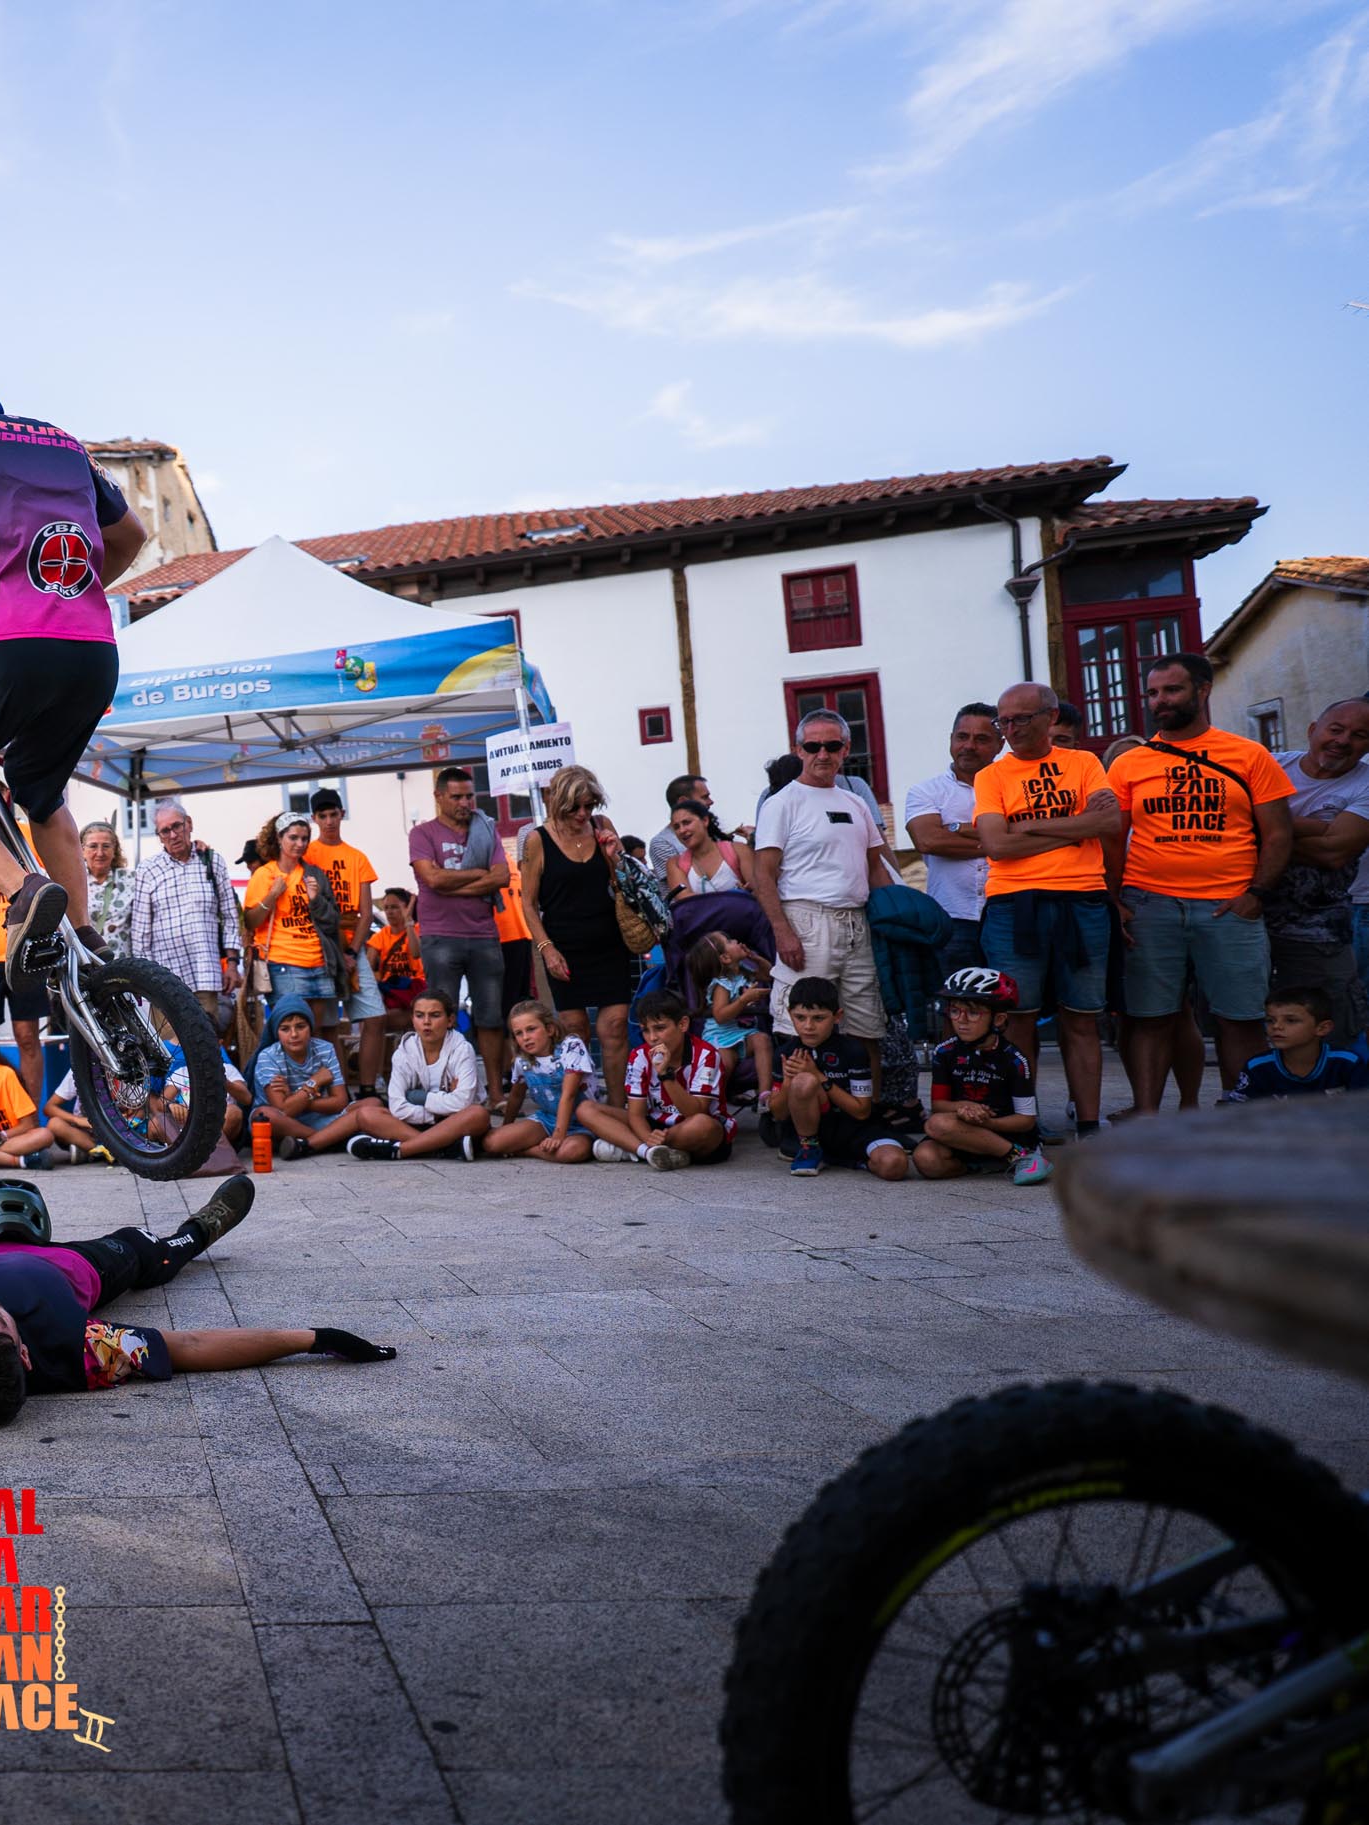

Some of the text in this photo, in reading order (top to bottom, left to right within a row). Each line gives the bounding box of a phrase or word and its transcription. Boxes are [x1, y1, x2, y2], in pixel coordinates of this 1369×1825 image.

[132, 678, 272, 707] de Burgos
[1040, 762, 1064, 778] AL
[1172, 764, 1203, 780] CA
[1028, 778, 1056, 795] CA
[1172, 778, 1220, 794] ZAR
[1031, 789, 1073, 809] ZAR
[1143, 795, 1220, 815] URBAN
[1172, 813, 1227, 831] RACE
[333, 860, 346, 870] AL
